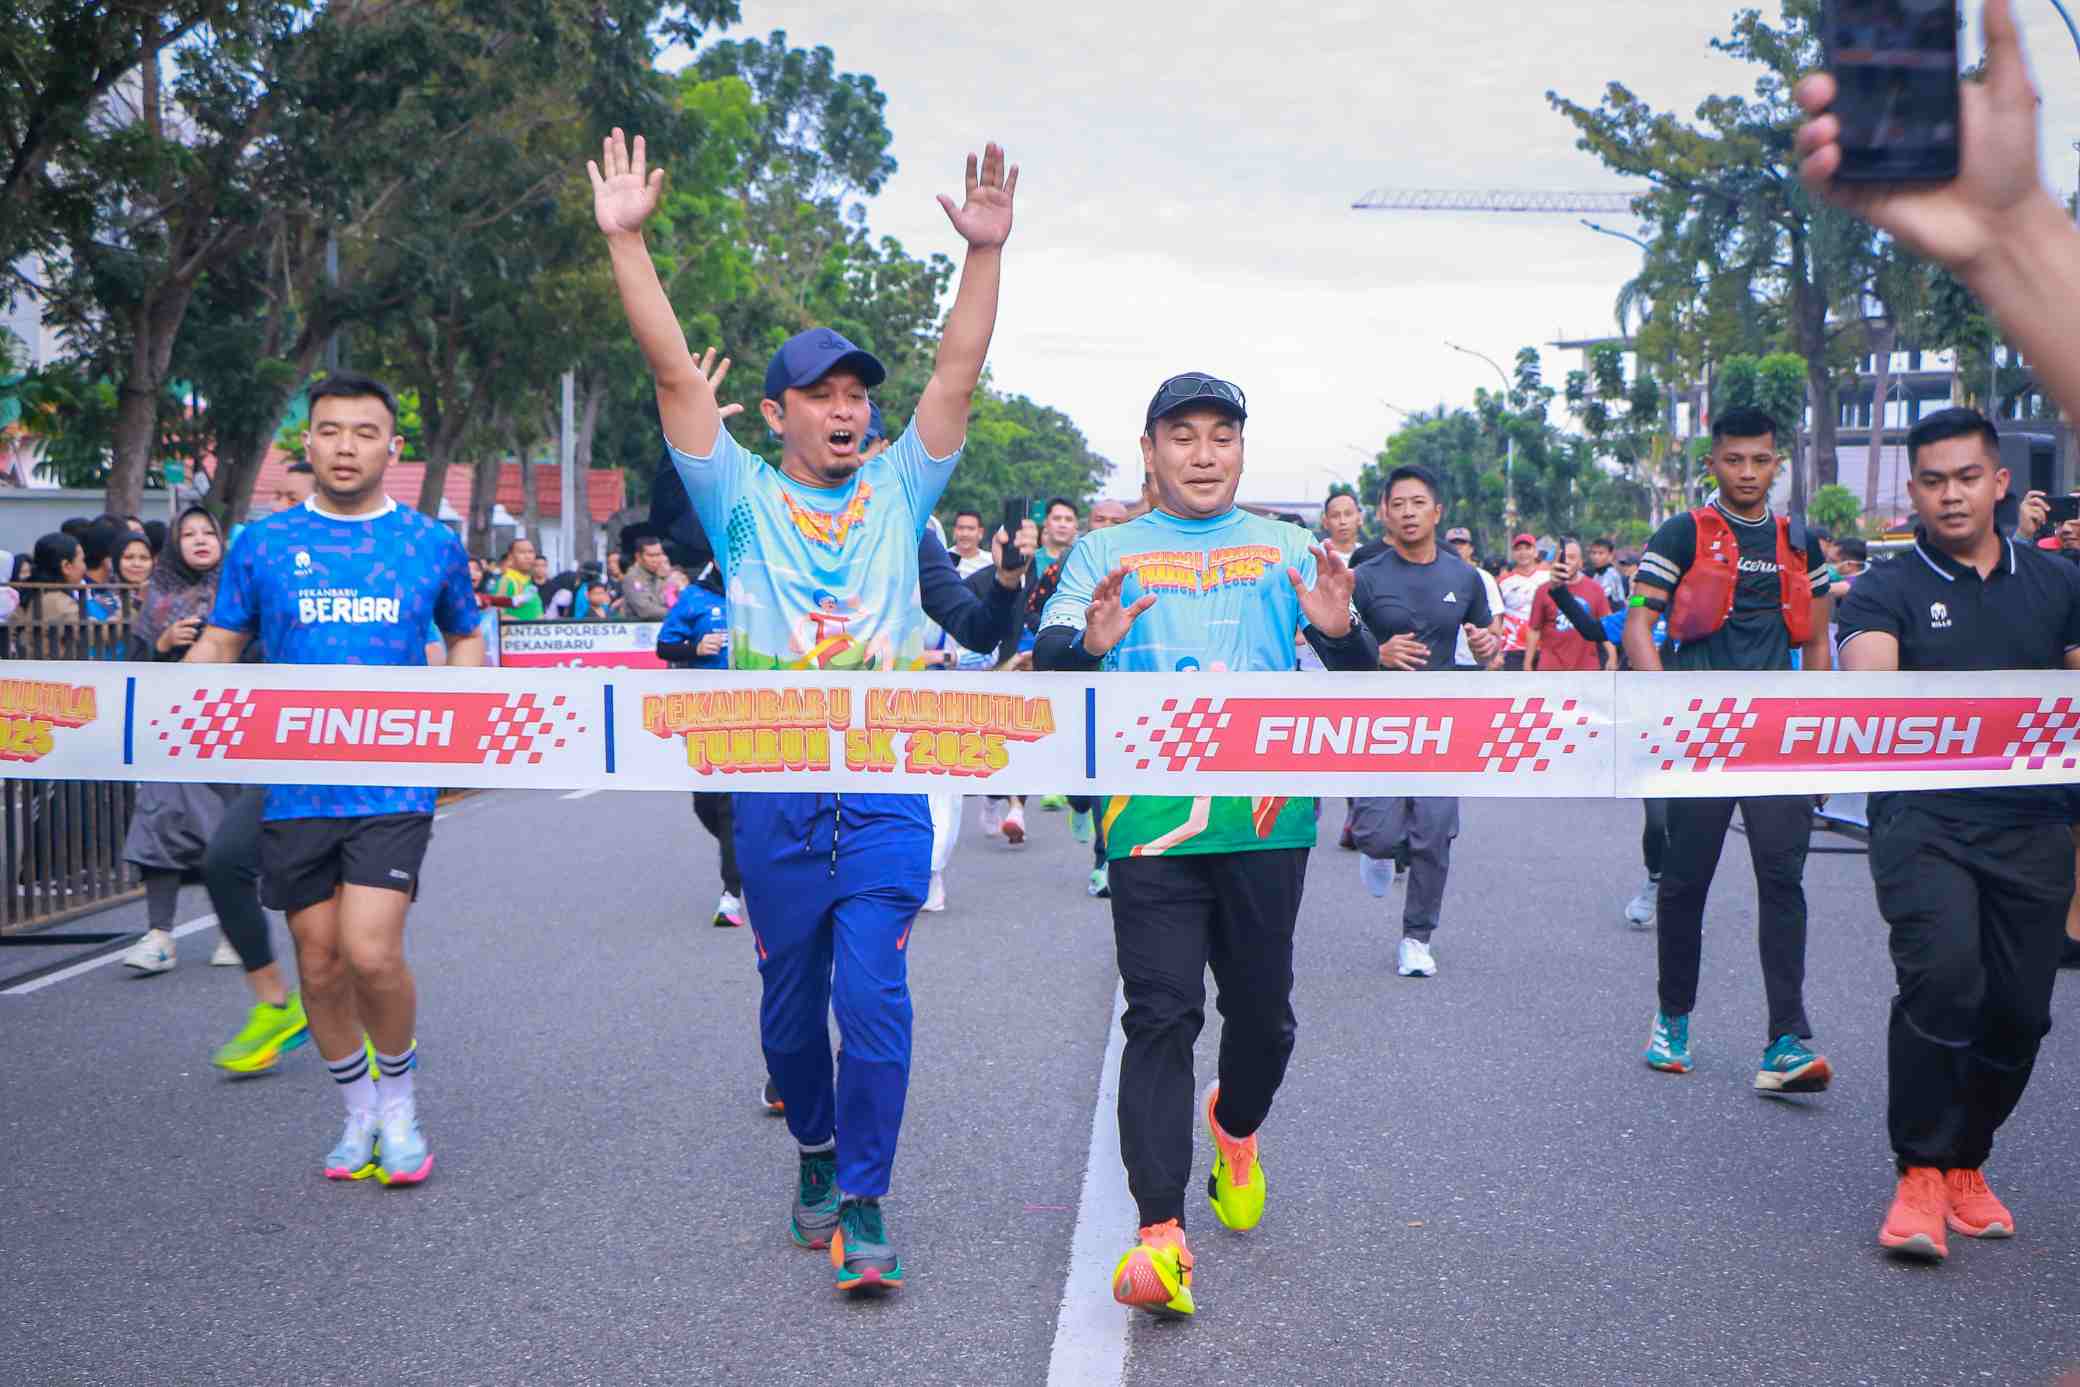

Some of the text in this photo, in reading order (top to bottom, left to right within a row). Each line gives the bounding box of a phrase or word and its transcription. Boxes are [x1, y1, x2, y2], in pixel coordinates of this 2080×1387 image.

[298, 597, 401, 624] BERLARI
[504, 639, 593, 651] PEKANBARU
[554, 624, 628, 637] POLRESTA
[275, 706, 455, 747] FINISH
[643, 688, 1056, 741] PEKANBARU KARHUTLA
[686, 728, 1009, 778] FUNRUN 5K 2025
[1254, 716, 1454, 755] FINISH
[1779, 716, 1982, 754] FINISH
